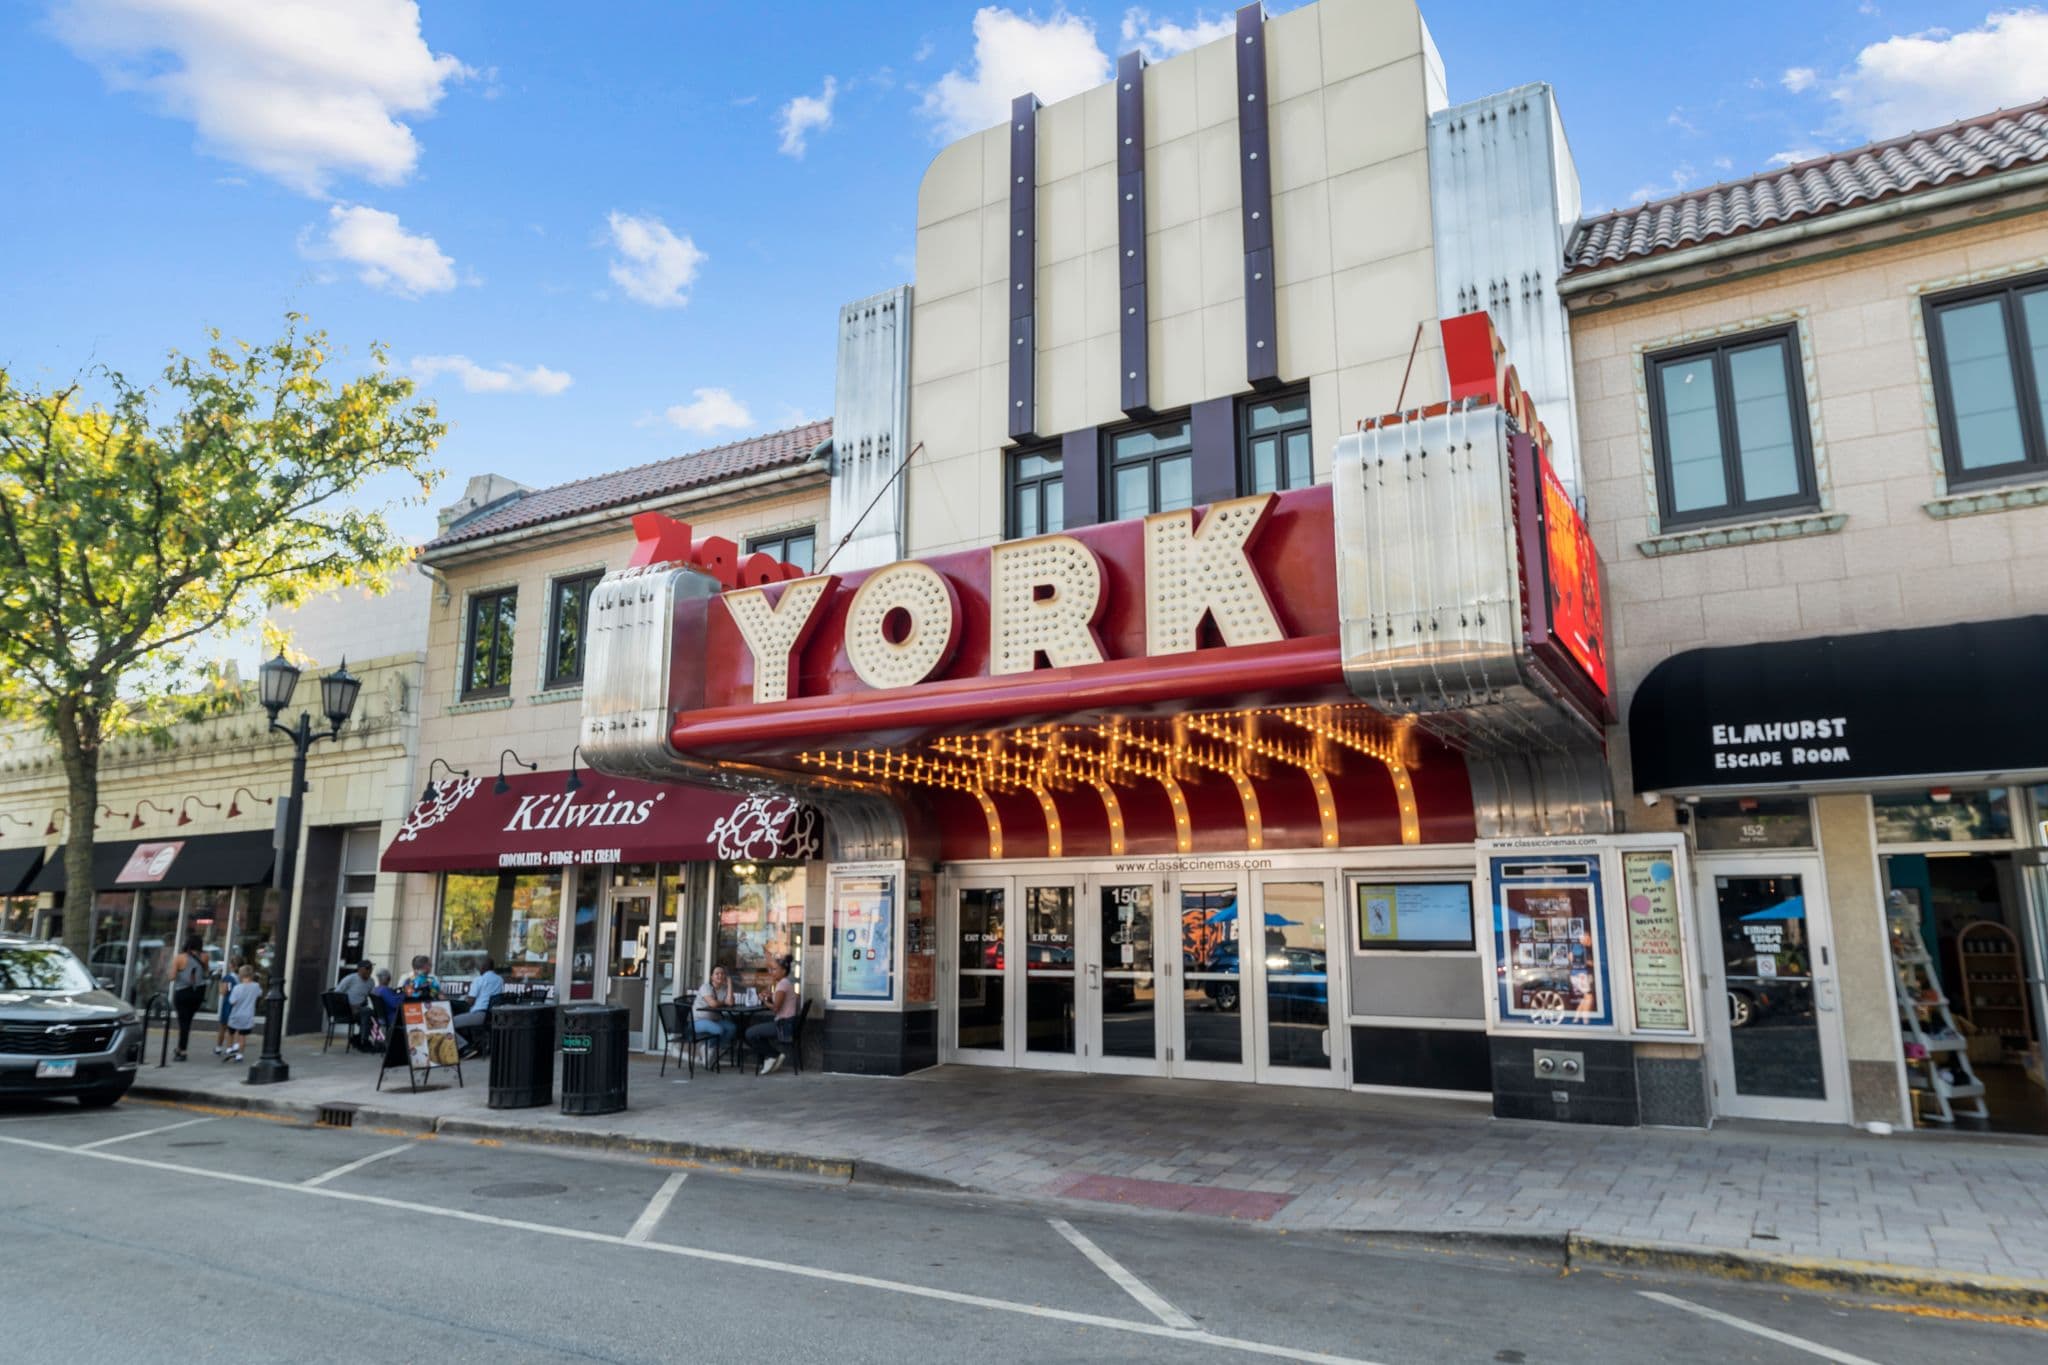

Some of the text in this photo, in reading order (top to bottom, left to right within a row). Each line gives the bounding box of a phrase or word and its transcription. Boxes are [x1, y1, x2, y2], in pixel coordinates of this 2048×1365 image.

[722, 492, 1288, 704] YORK
[1712, 717, 1847, 745] ELMHURST
[1714, 746, 1850, 769] ESCAPE ROOM
[503, 789, 656, 832] Kilwins
[1741, 825, 1765, 836] 152
[1493, 838, 1598, 849] www.classiccinemas.com
[499, 848, 621, 867] CHOCOLATES FUDGE ICE CREAM
[1115, 858, 1272, 872] www.classiccinemas.com
[1112, 888, 1140, 904] 150
[965, 934, 979, 942] EXIT
[1032, 934, 1068, 942] EXIT ONLY
